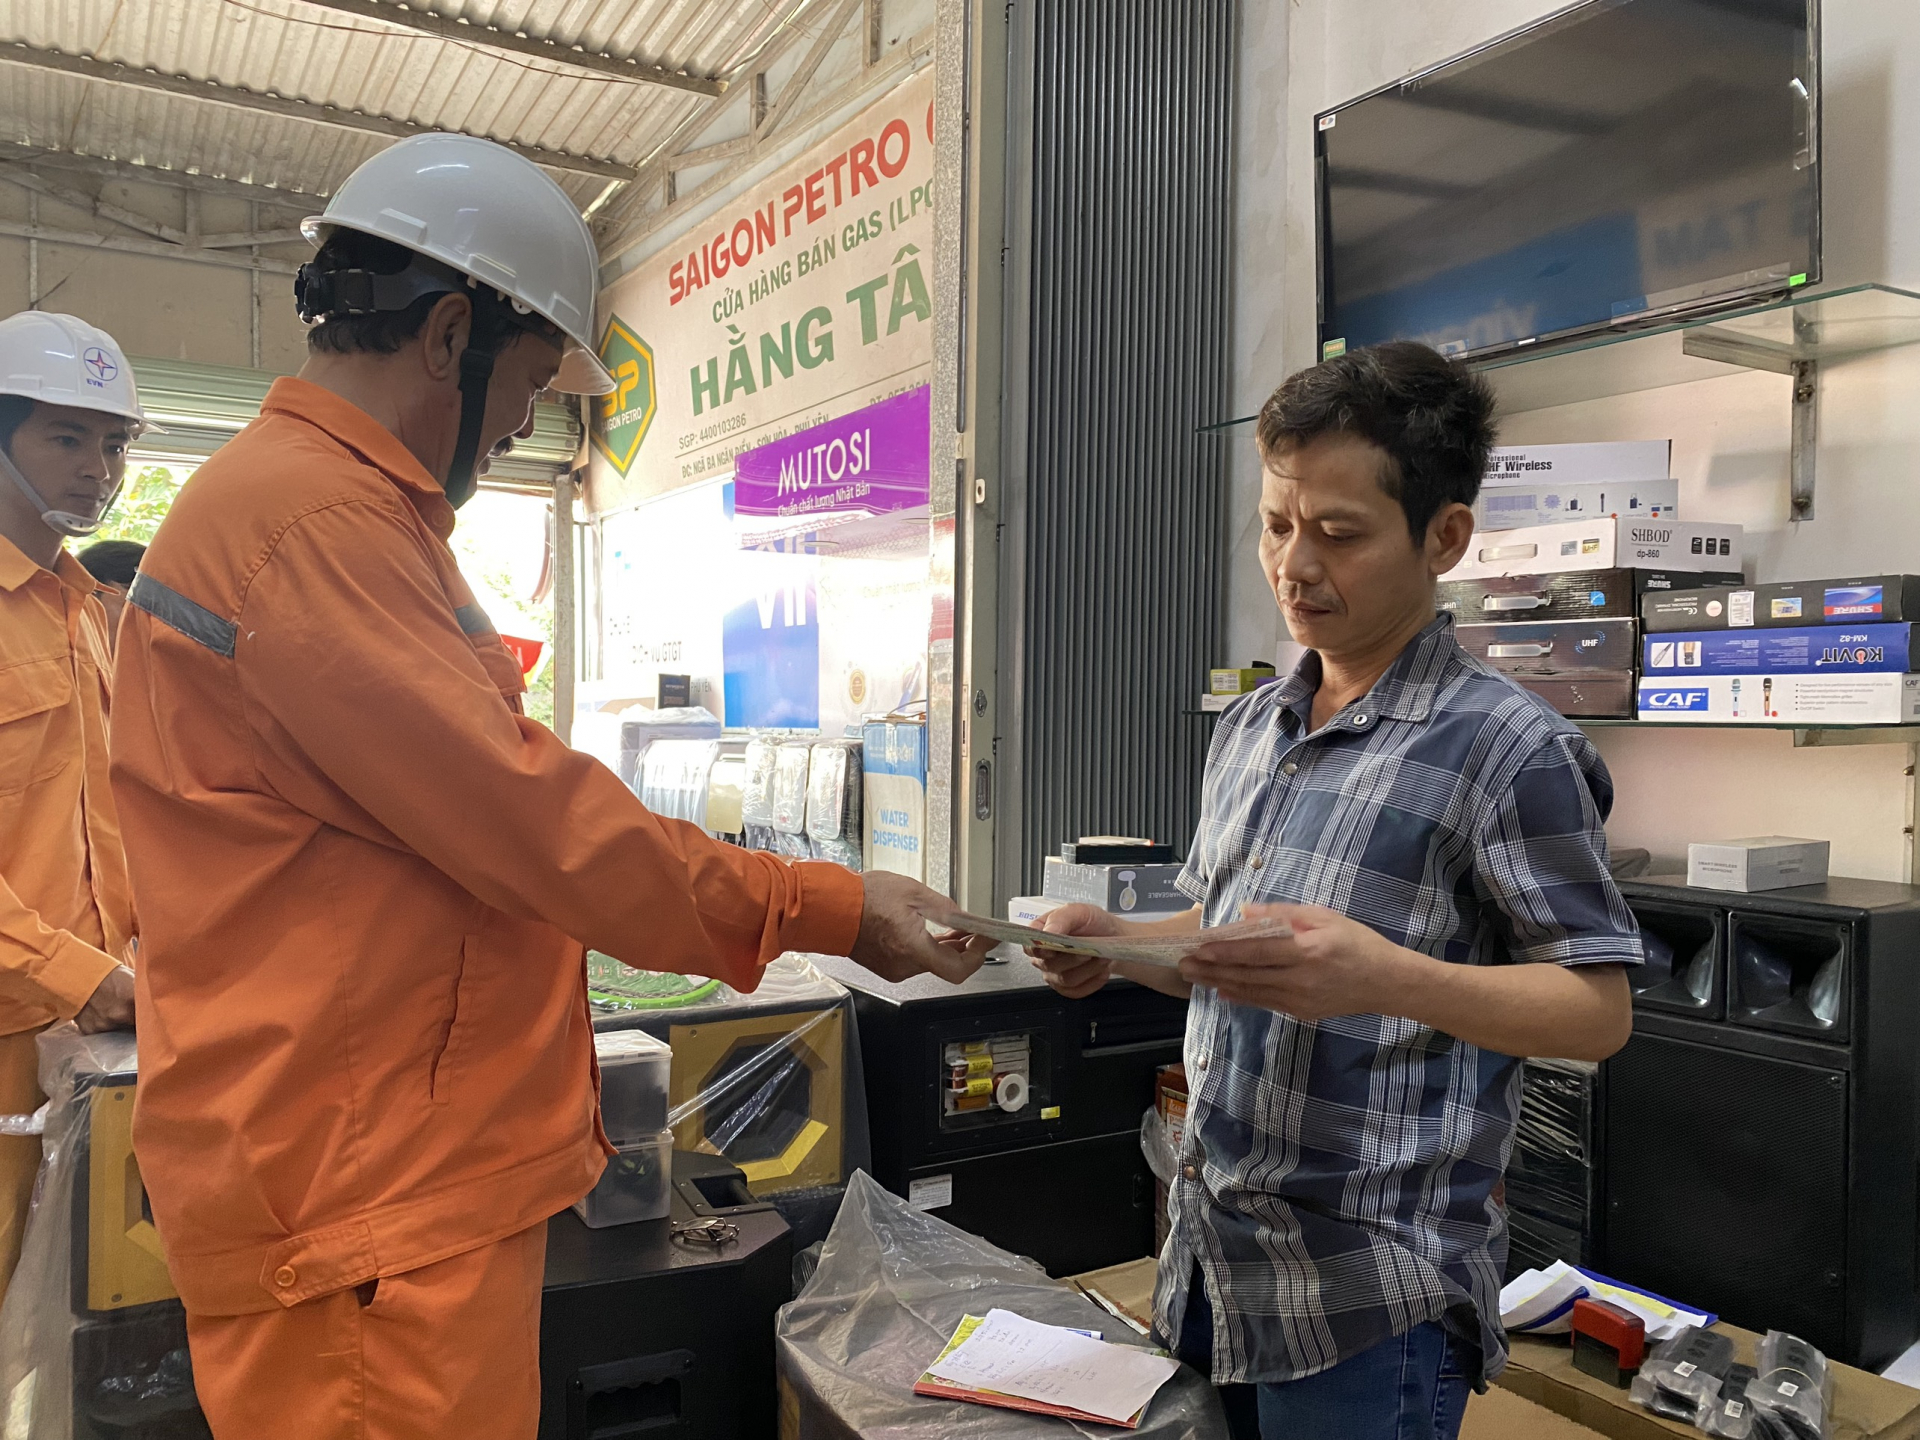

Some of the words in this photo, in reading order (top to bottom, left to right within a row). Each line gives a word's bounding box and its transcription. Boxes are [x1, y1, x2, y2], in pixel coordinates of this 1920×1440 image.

[712, 287, 745, 323] CỬA
[748, 269, 792, 305] HÀNG
[797, 236, 836, 278] BÁN
[842, 210, 883, 252] GAS
[690, 306, 835, 417] HẰNG
[86, 378, 103, 388] EVN
[621, 406, 642, 426] PETRO
[678, 434, 698, 450] SGP:
[699, 413, 747, 441] 4400103286
[706, 455, 715, 472] BA
[777, 428, 870, 497] MUTOSI
[1505, 461, 1553, 472] Wireless
[836, 486, 854, 503] Nhật
[855, 480, 870, 498] Bản
[1636, 549, 1660, 559] dp-860
[1833, 605, 1873, 615] SHURE
[1582, 638, 1599, 648] UHF
[1839, 634, 1868, 643] KM-82
[1648, 692, 1703, 706] CAF
[880, 808, 909, 828] WATER
[872, 830, 919, 854] DISPENSER
